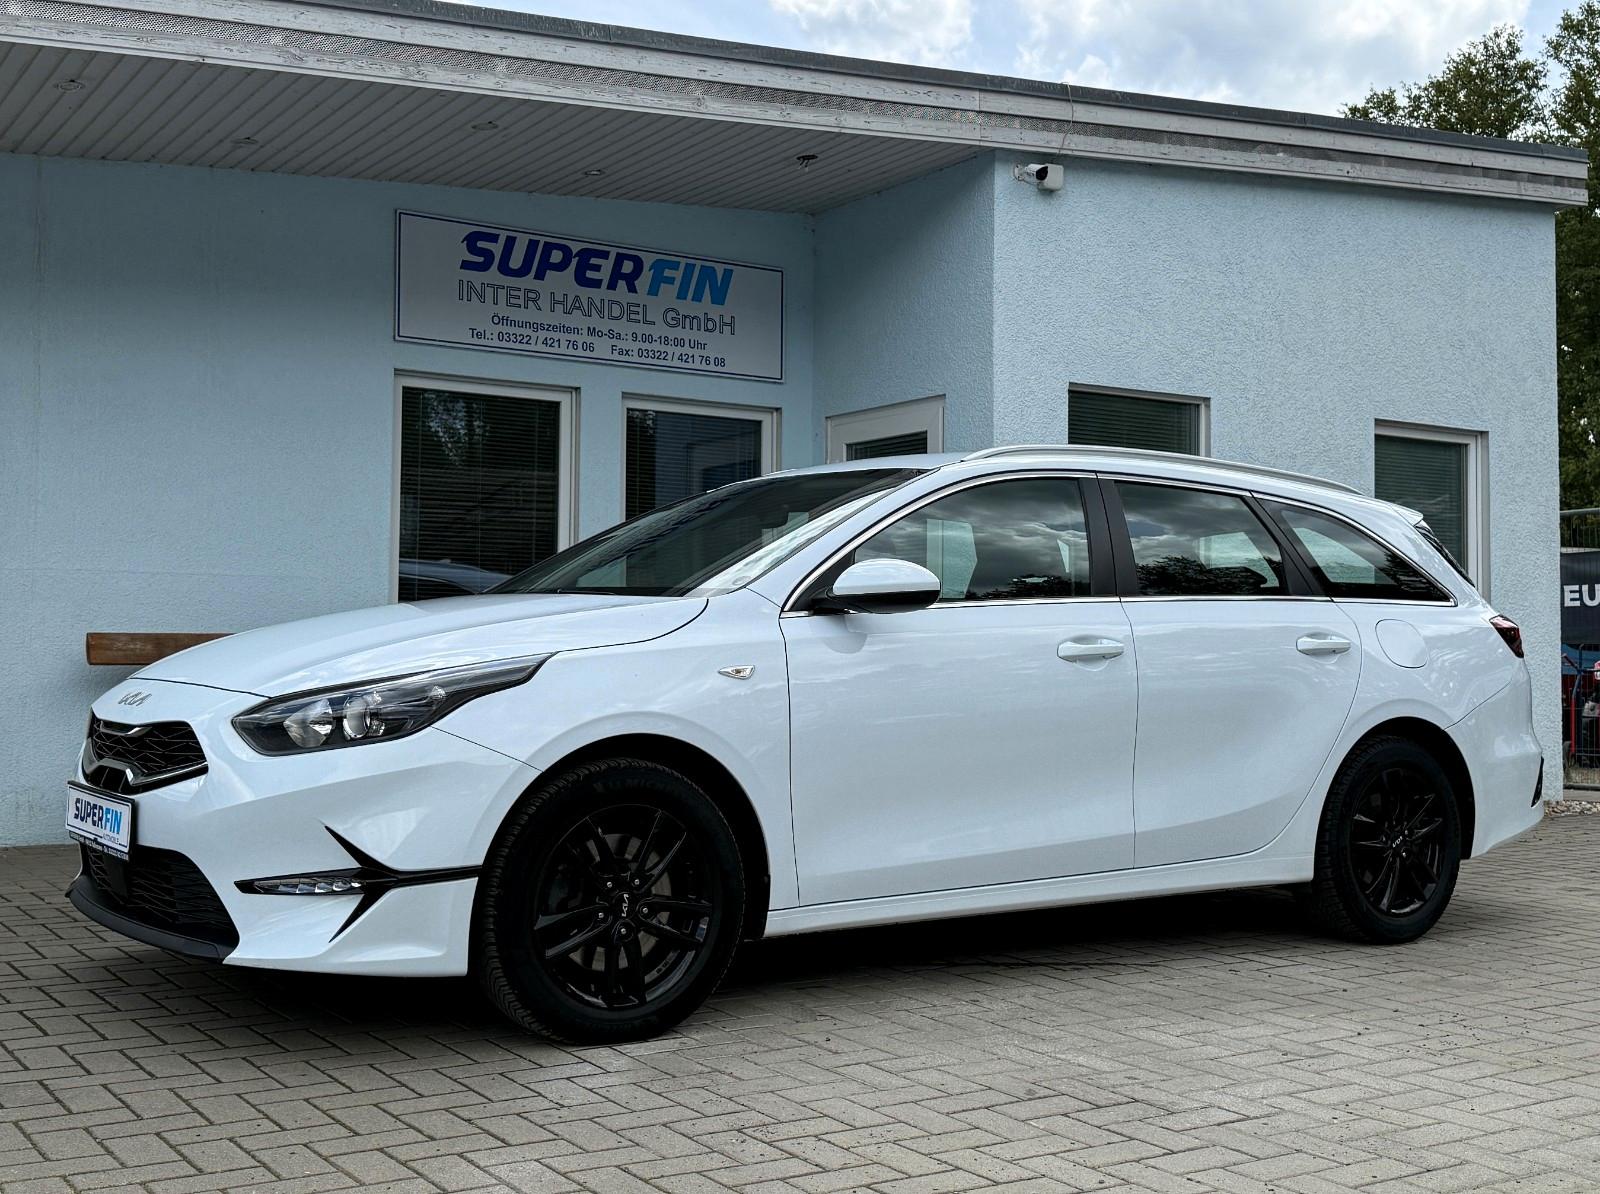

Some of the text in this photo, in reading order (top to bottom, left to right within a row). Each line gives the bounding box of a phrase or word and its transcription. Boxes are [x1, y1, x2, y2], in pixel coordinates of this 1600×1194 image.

[458, 279, 736, 335] INTER HANDEL GmbH
[469, 327, 595, 353] Tel.: 03322 / 421 76 06
[491, 312, 708, 351] Öffnungszeiten: Mo-Sa.: 9.00-18:00 Uhr
[610, 344, 726, 368] Fax: 03322 / 421 76 08
